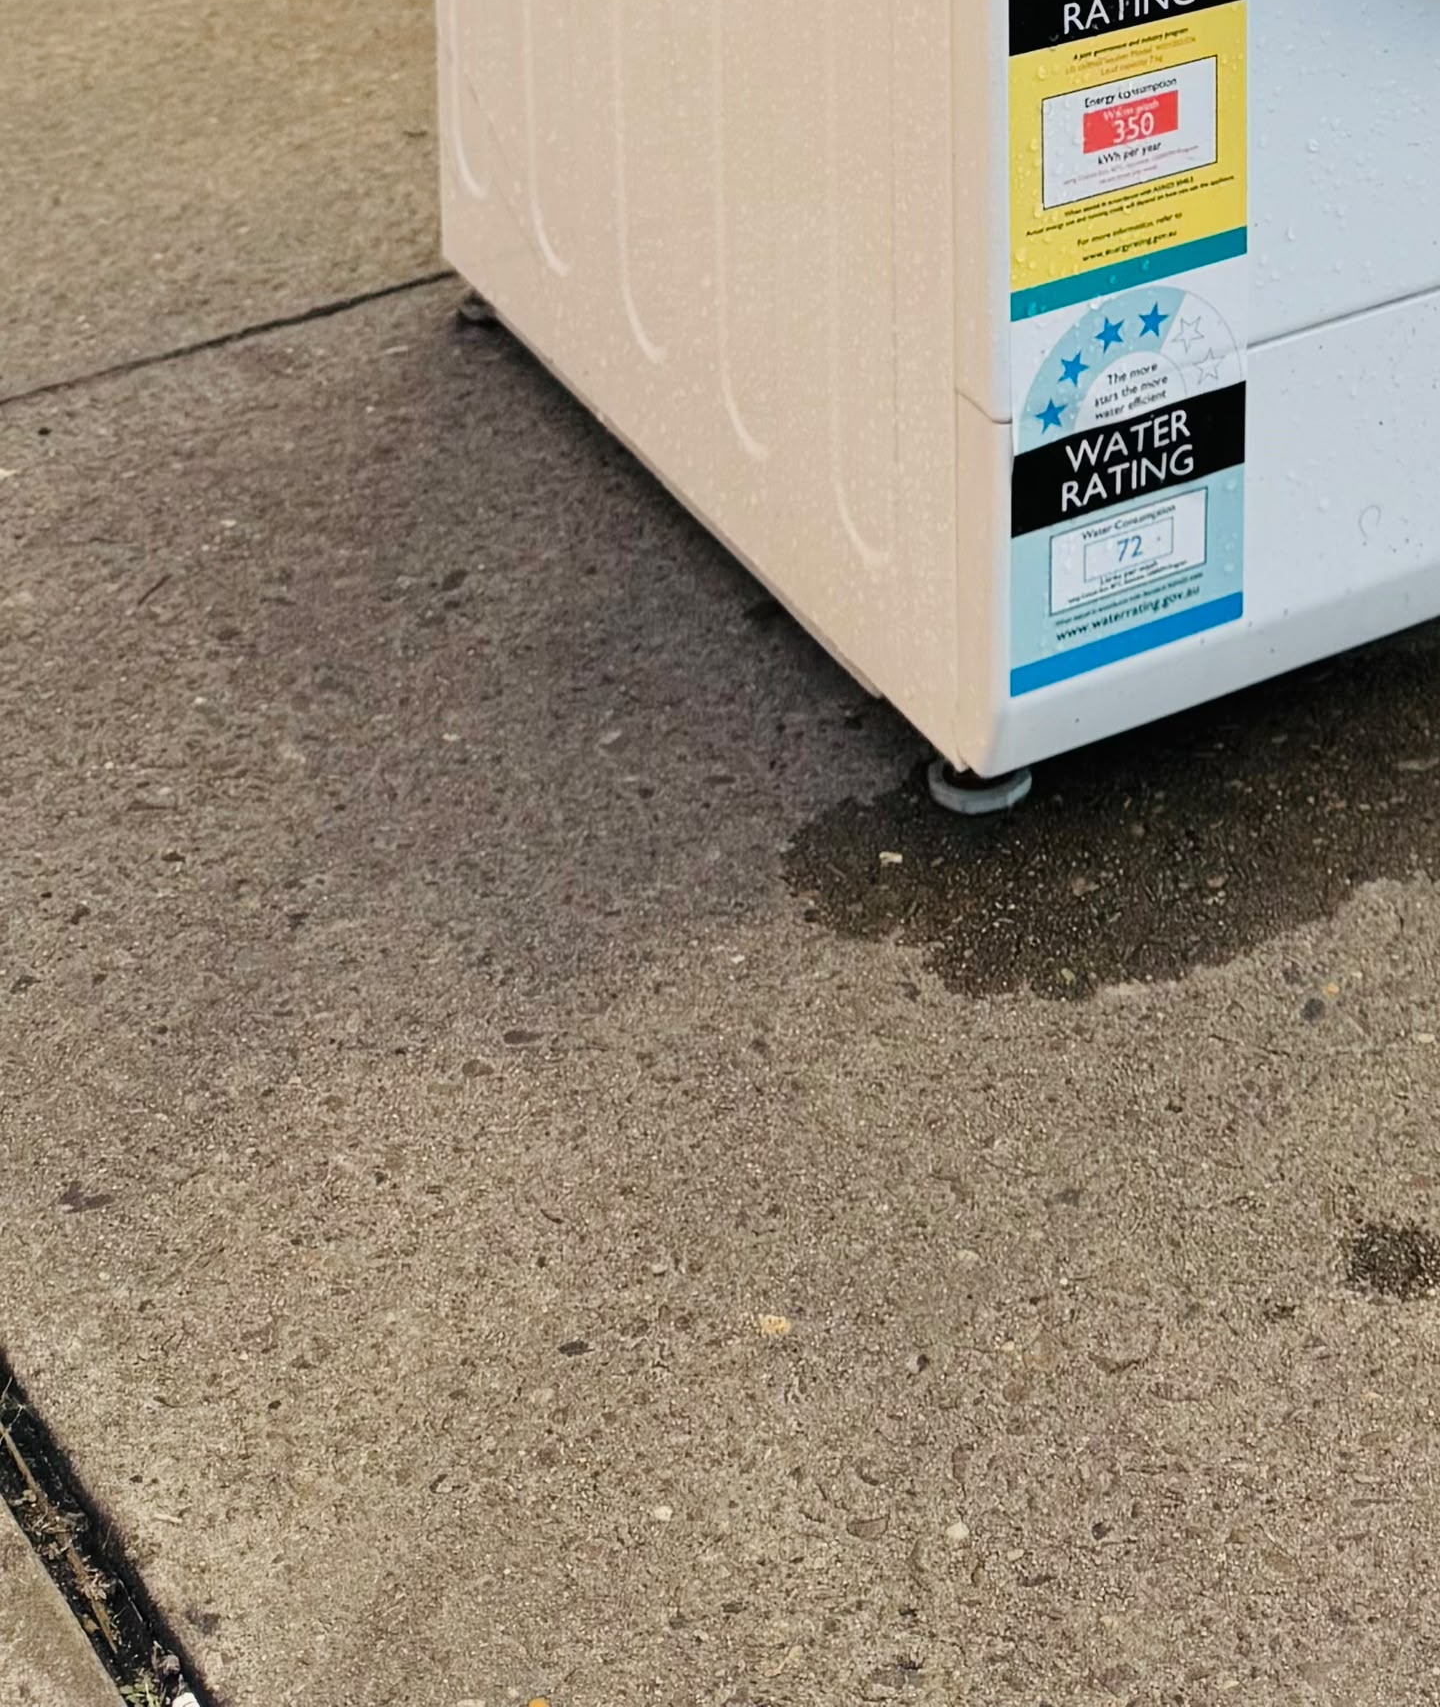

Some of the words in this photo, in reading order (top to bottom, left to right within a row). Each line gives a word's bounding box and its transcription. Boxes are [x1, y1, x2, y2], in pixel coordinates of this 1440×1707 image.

[1084, 94, 1116, 109] Energy
[1112, 111, 1155, 144] 350
[1098, 150, 1121, 165] kWh
[1123, 146, 1140, 161] per
[1142, 142, 1162, 156] year
[1077, 237, 1090, 247] For
[1091, 232, 1111, 244] more
[1156, 213, 1174, 225] refer
[1106, 369, 1127, 386] The
[1129, 362, 1158, 381] more
[1094, 390, 1119, 408] stars
[1121, 382, 1139, 397] the
[1140, 375, 1168, 393] more
[1095, 404, 1125, 421] water
[1127, 389, 1167, 412] efficient
[1065, 409, 1191, 473] WATER
[1061, 444, 1194, 512] RATING
[1081, 524, 1112, 540] Water
[1117, 535, 1143, 562] 72
